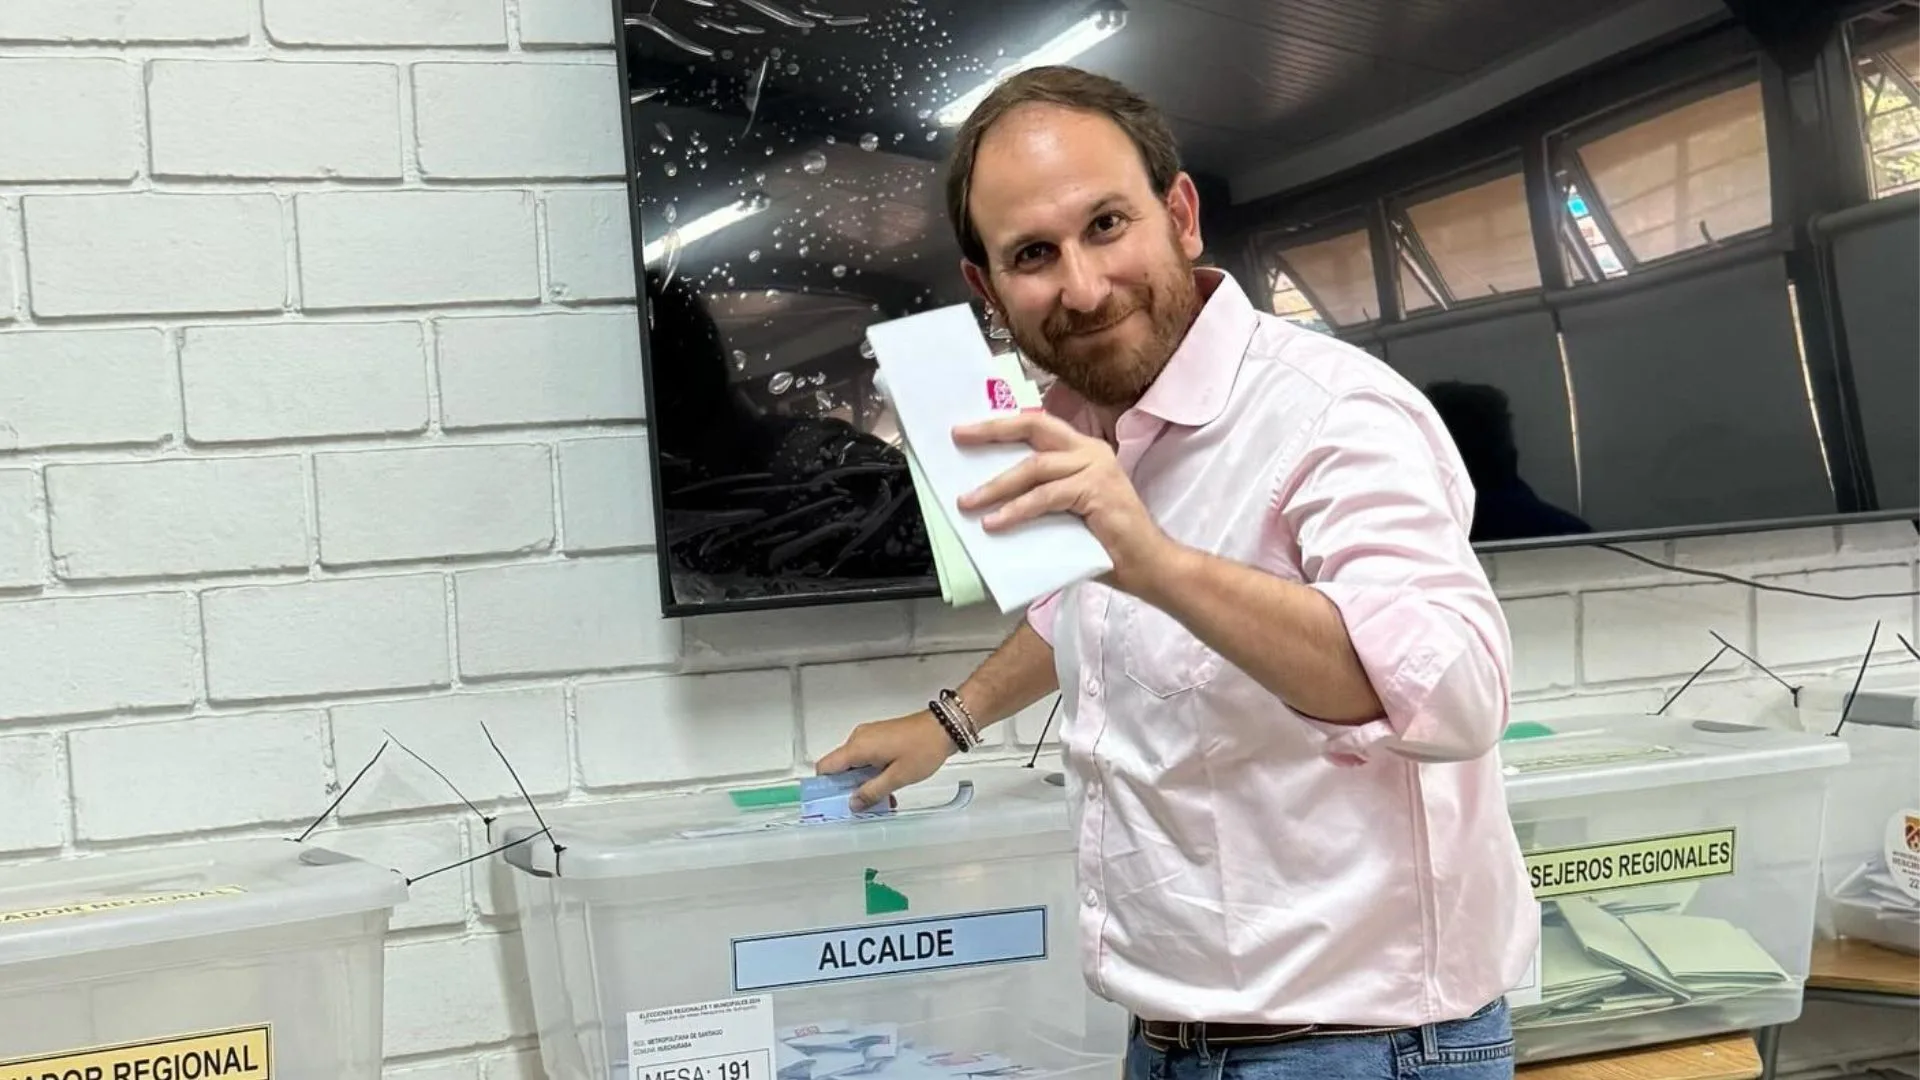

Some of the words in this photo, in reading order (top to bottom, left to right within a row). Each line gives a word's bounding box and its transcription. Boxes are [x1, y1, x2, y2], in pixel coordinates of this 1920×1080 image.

[1528, 857, 1613, 888] SEJEROS
[1619, 842, 1730, 878] REGIONALES
[818, 928, 954, 970] ALCALDE
[113, 1045, 258, 1080] REGIONAL
[718, 1060, 750, 1080] 191
